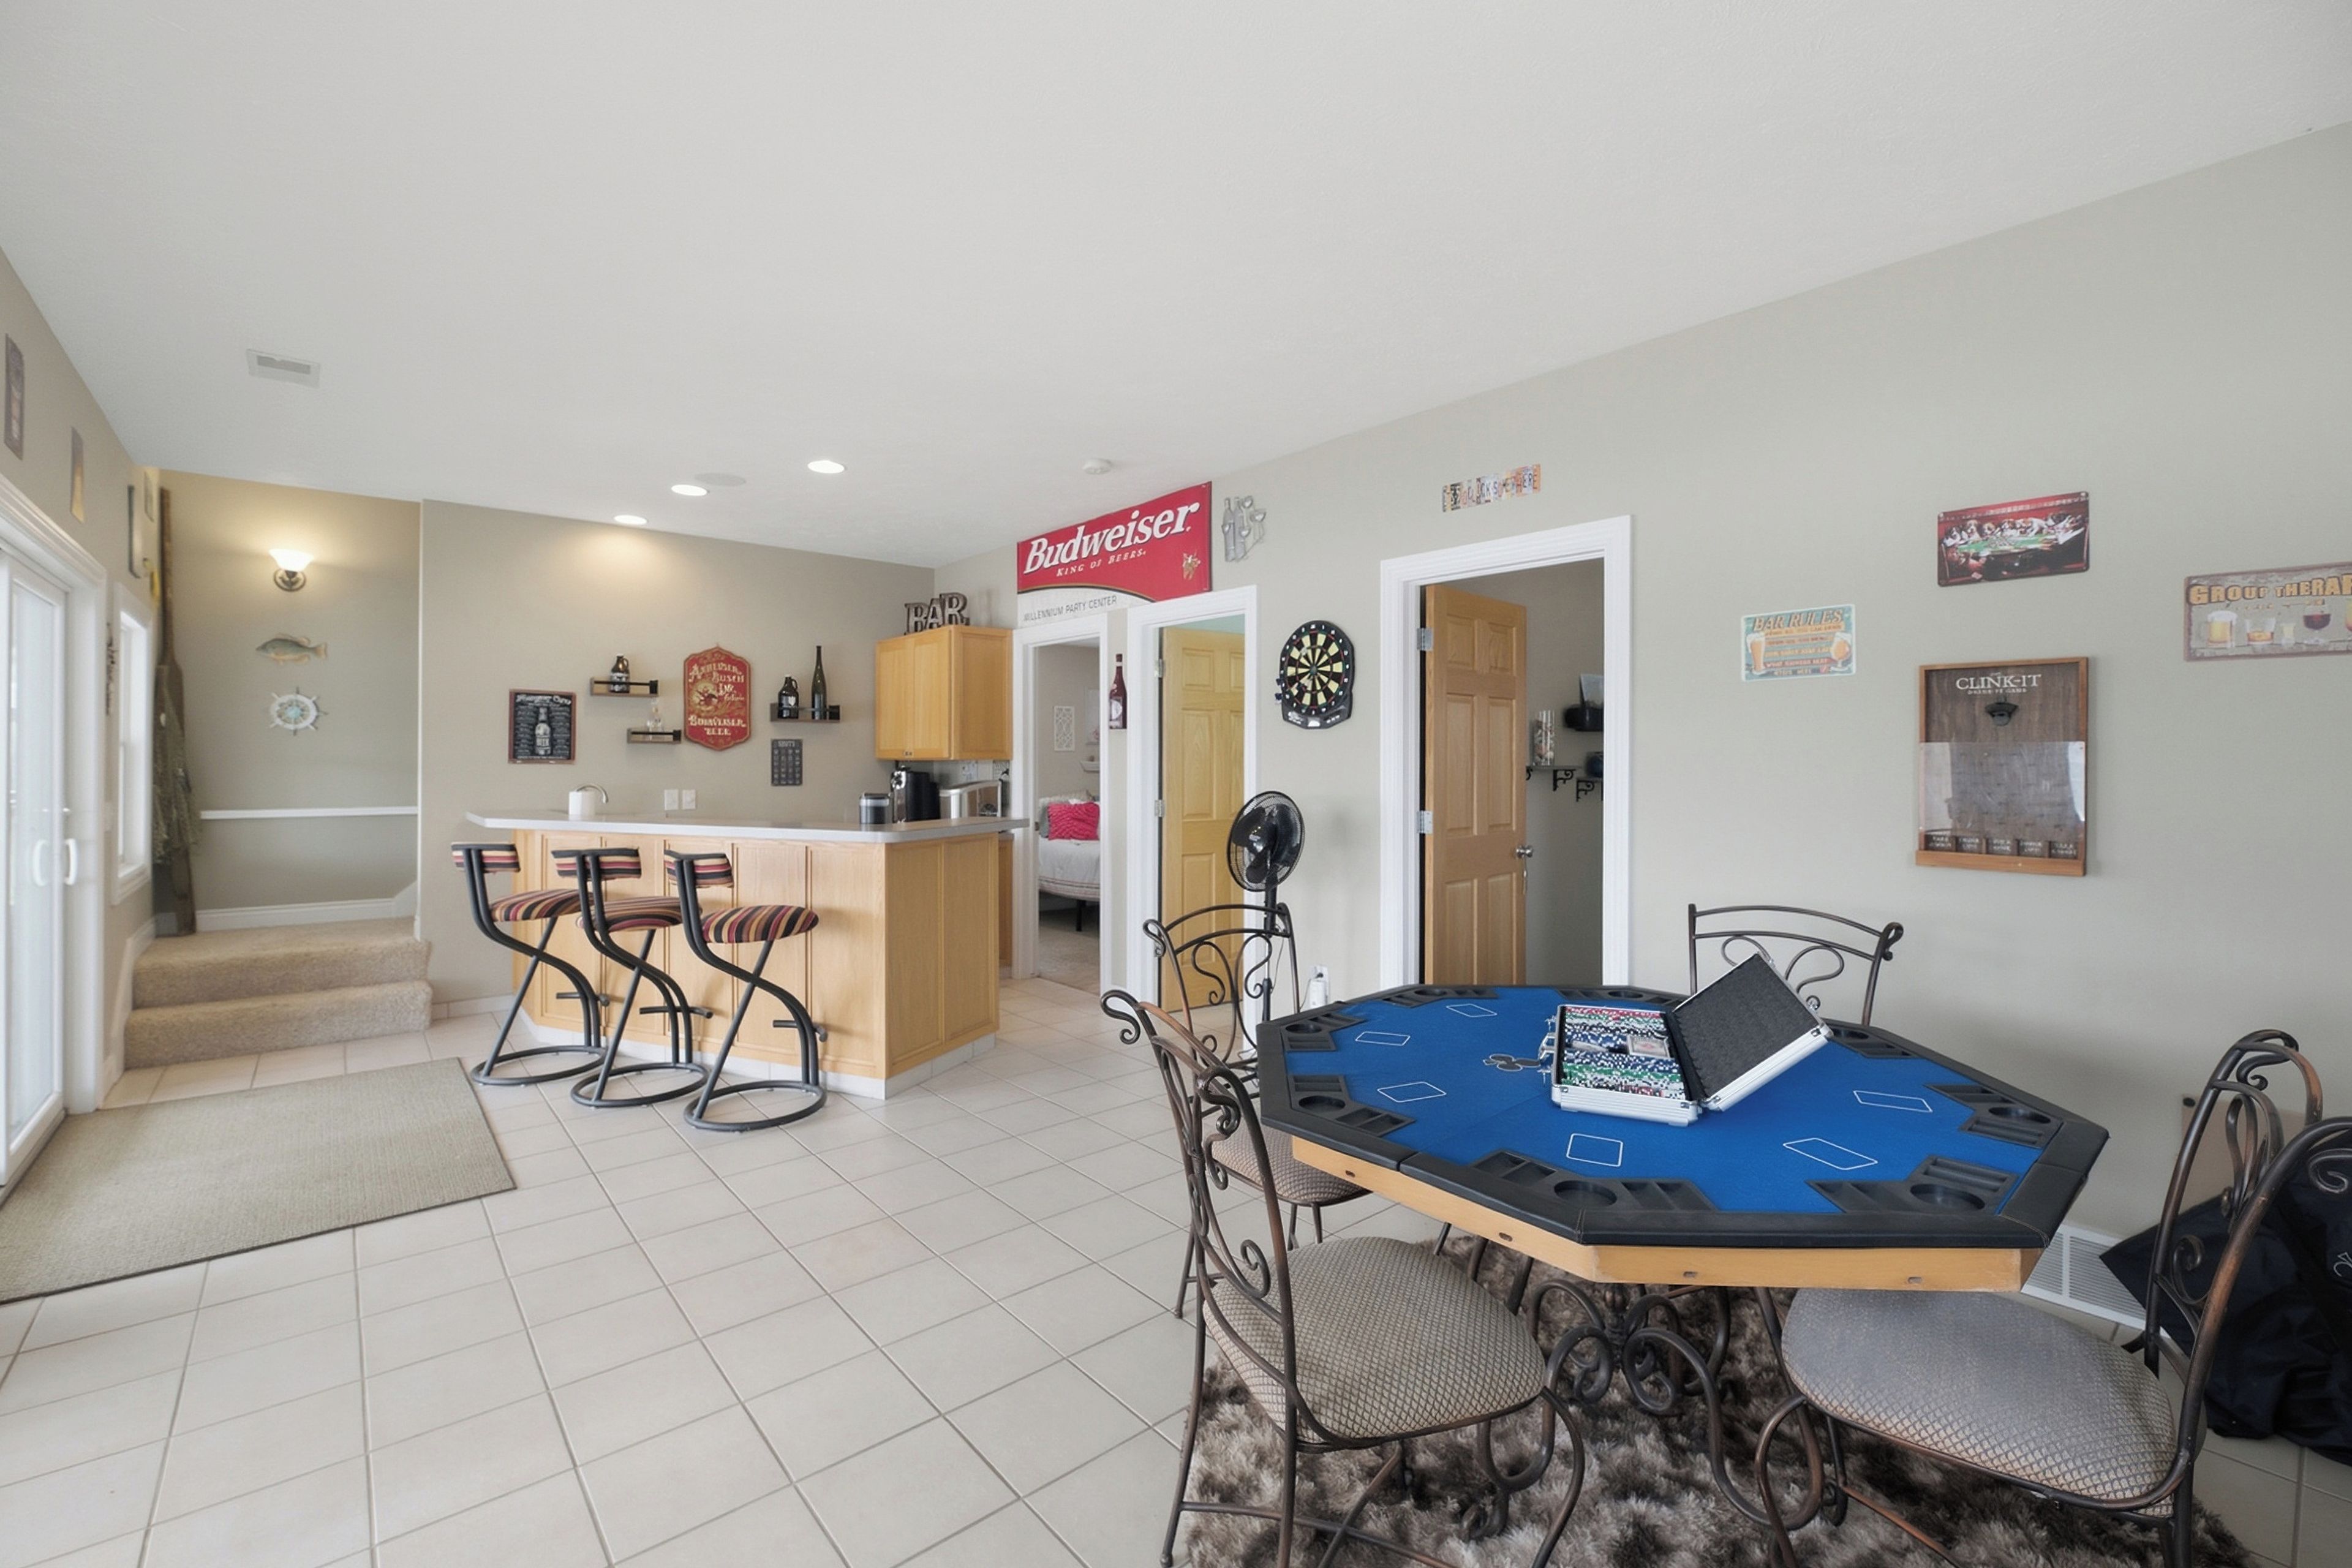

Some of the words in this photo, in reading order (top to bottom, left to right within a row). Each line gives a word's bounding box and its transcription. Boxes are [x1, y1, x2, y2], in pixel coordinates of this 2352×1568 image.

[1023, 502, 1200, 575] Budweiser
[1057, 564, 1084, 576] KING
[1090, 559, 1101, 568] OF
[1108, 549, 1143, 564] BEERS
[1023, 606, 1064, 621] MILLENNIUM
[1065, 601, 1087, 614] PARTY
[1088, 595, 1118, 609] CENTER
[2187, 584, 2269, 606] GROUP
[904, 592, 970, 636] BAR
[1753, 615, 1785, 631] BAR
[1789, 609, 1843, 628] RULES
[1956, 674, 2041, 690] CLINK-IT
